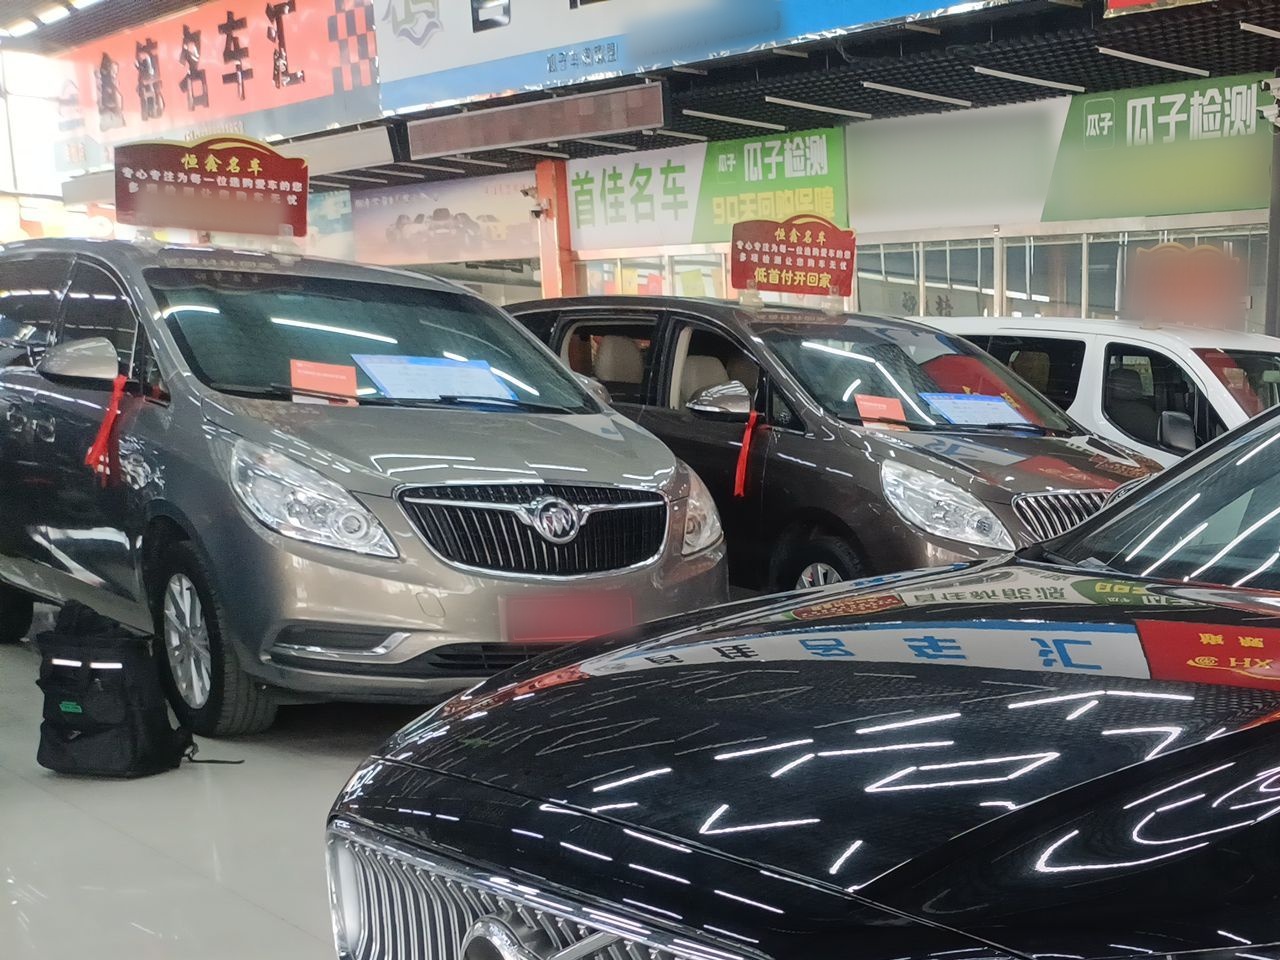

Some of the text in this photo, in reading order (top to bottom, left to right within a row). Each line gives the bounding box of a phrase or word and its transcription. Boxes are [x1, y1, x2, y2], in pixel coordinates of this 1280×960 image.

[1086, 112, 1113, 137] 瓜子
[1127, 83, 1257, 147] 瓜子检测
[180, 153, 263, 177] 恒鑫名车
[718, 154, 736, 173] 瓜子
[744, 134, 828, 182] 瓜子检测
[571, 159, 689, 230] 首佳名车
[754, 267, 832, 288] 低首付开回家
